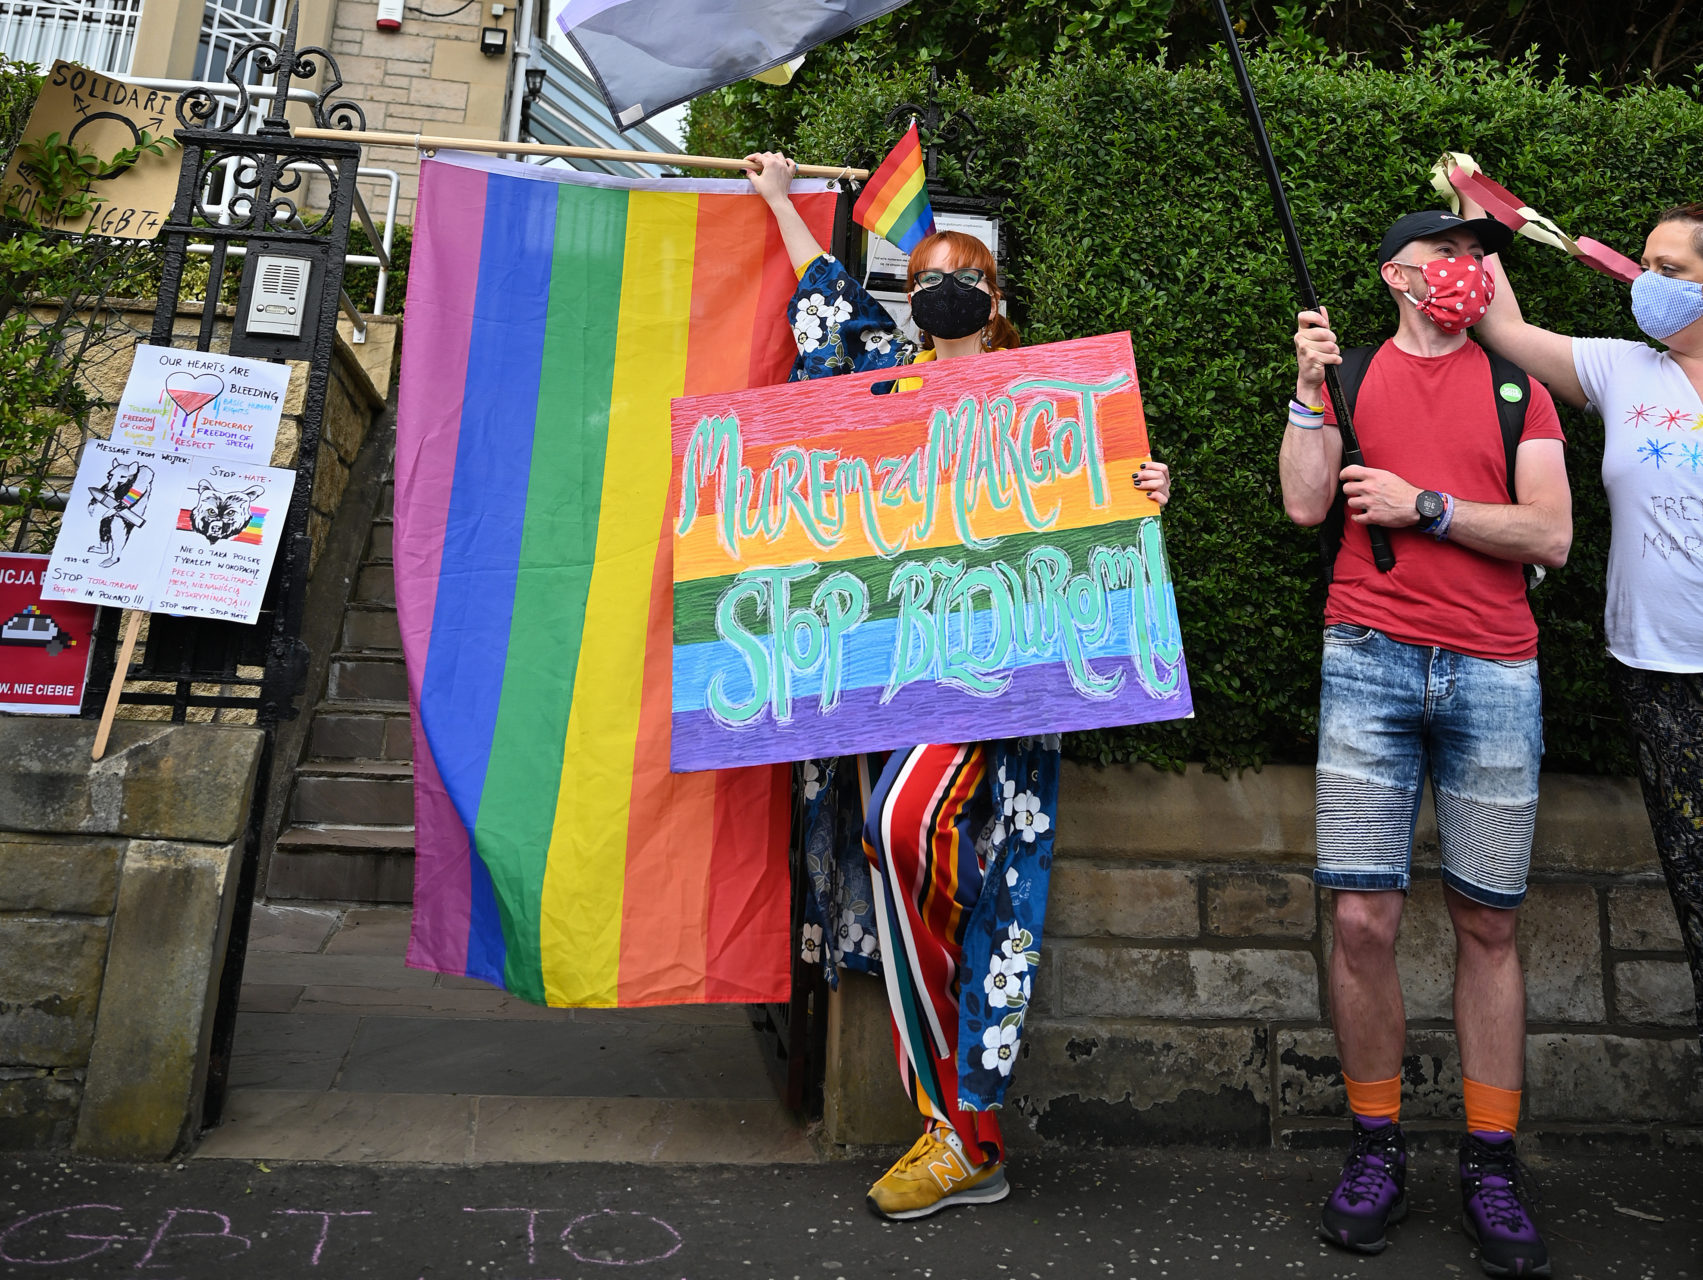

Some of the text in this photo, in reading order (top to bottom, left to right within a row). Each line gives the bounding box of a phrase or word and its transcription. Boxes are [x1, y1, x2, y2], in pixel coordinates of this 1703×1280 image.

[159, 355, 250, 378] OUR HEARTS ARE
[229, 383, 279, 404] BLEEDING
[201, 417, 254, 432] DEMOCRACY
[196, 428, 237, 439] FREEDOM
[95, 442, 131, 455] MESSAGE
[174, 437, 216, 450] RESPECT
[225, 439, 254, 450] SPEECH
[912, 372, 1135, 552] MARGOT
[244, 474, 267, 483] HATE
[1650, 495, 1703, 522] FRE
[179, 545, 193, 554] NIE
[0, 569, 36, 586] CJA
[84, 588, 95, 597] IN
[13, 684, 35, 695] NIE
[35, 685, 75, 697] CIEBIE
[927, 1150, 968, 1193] N
